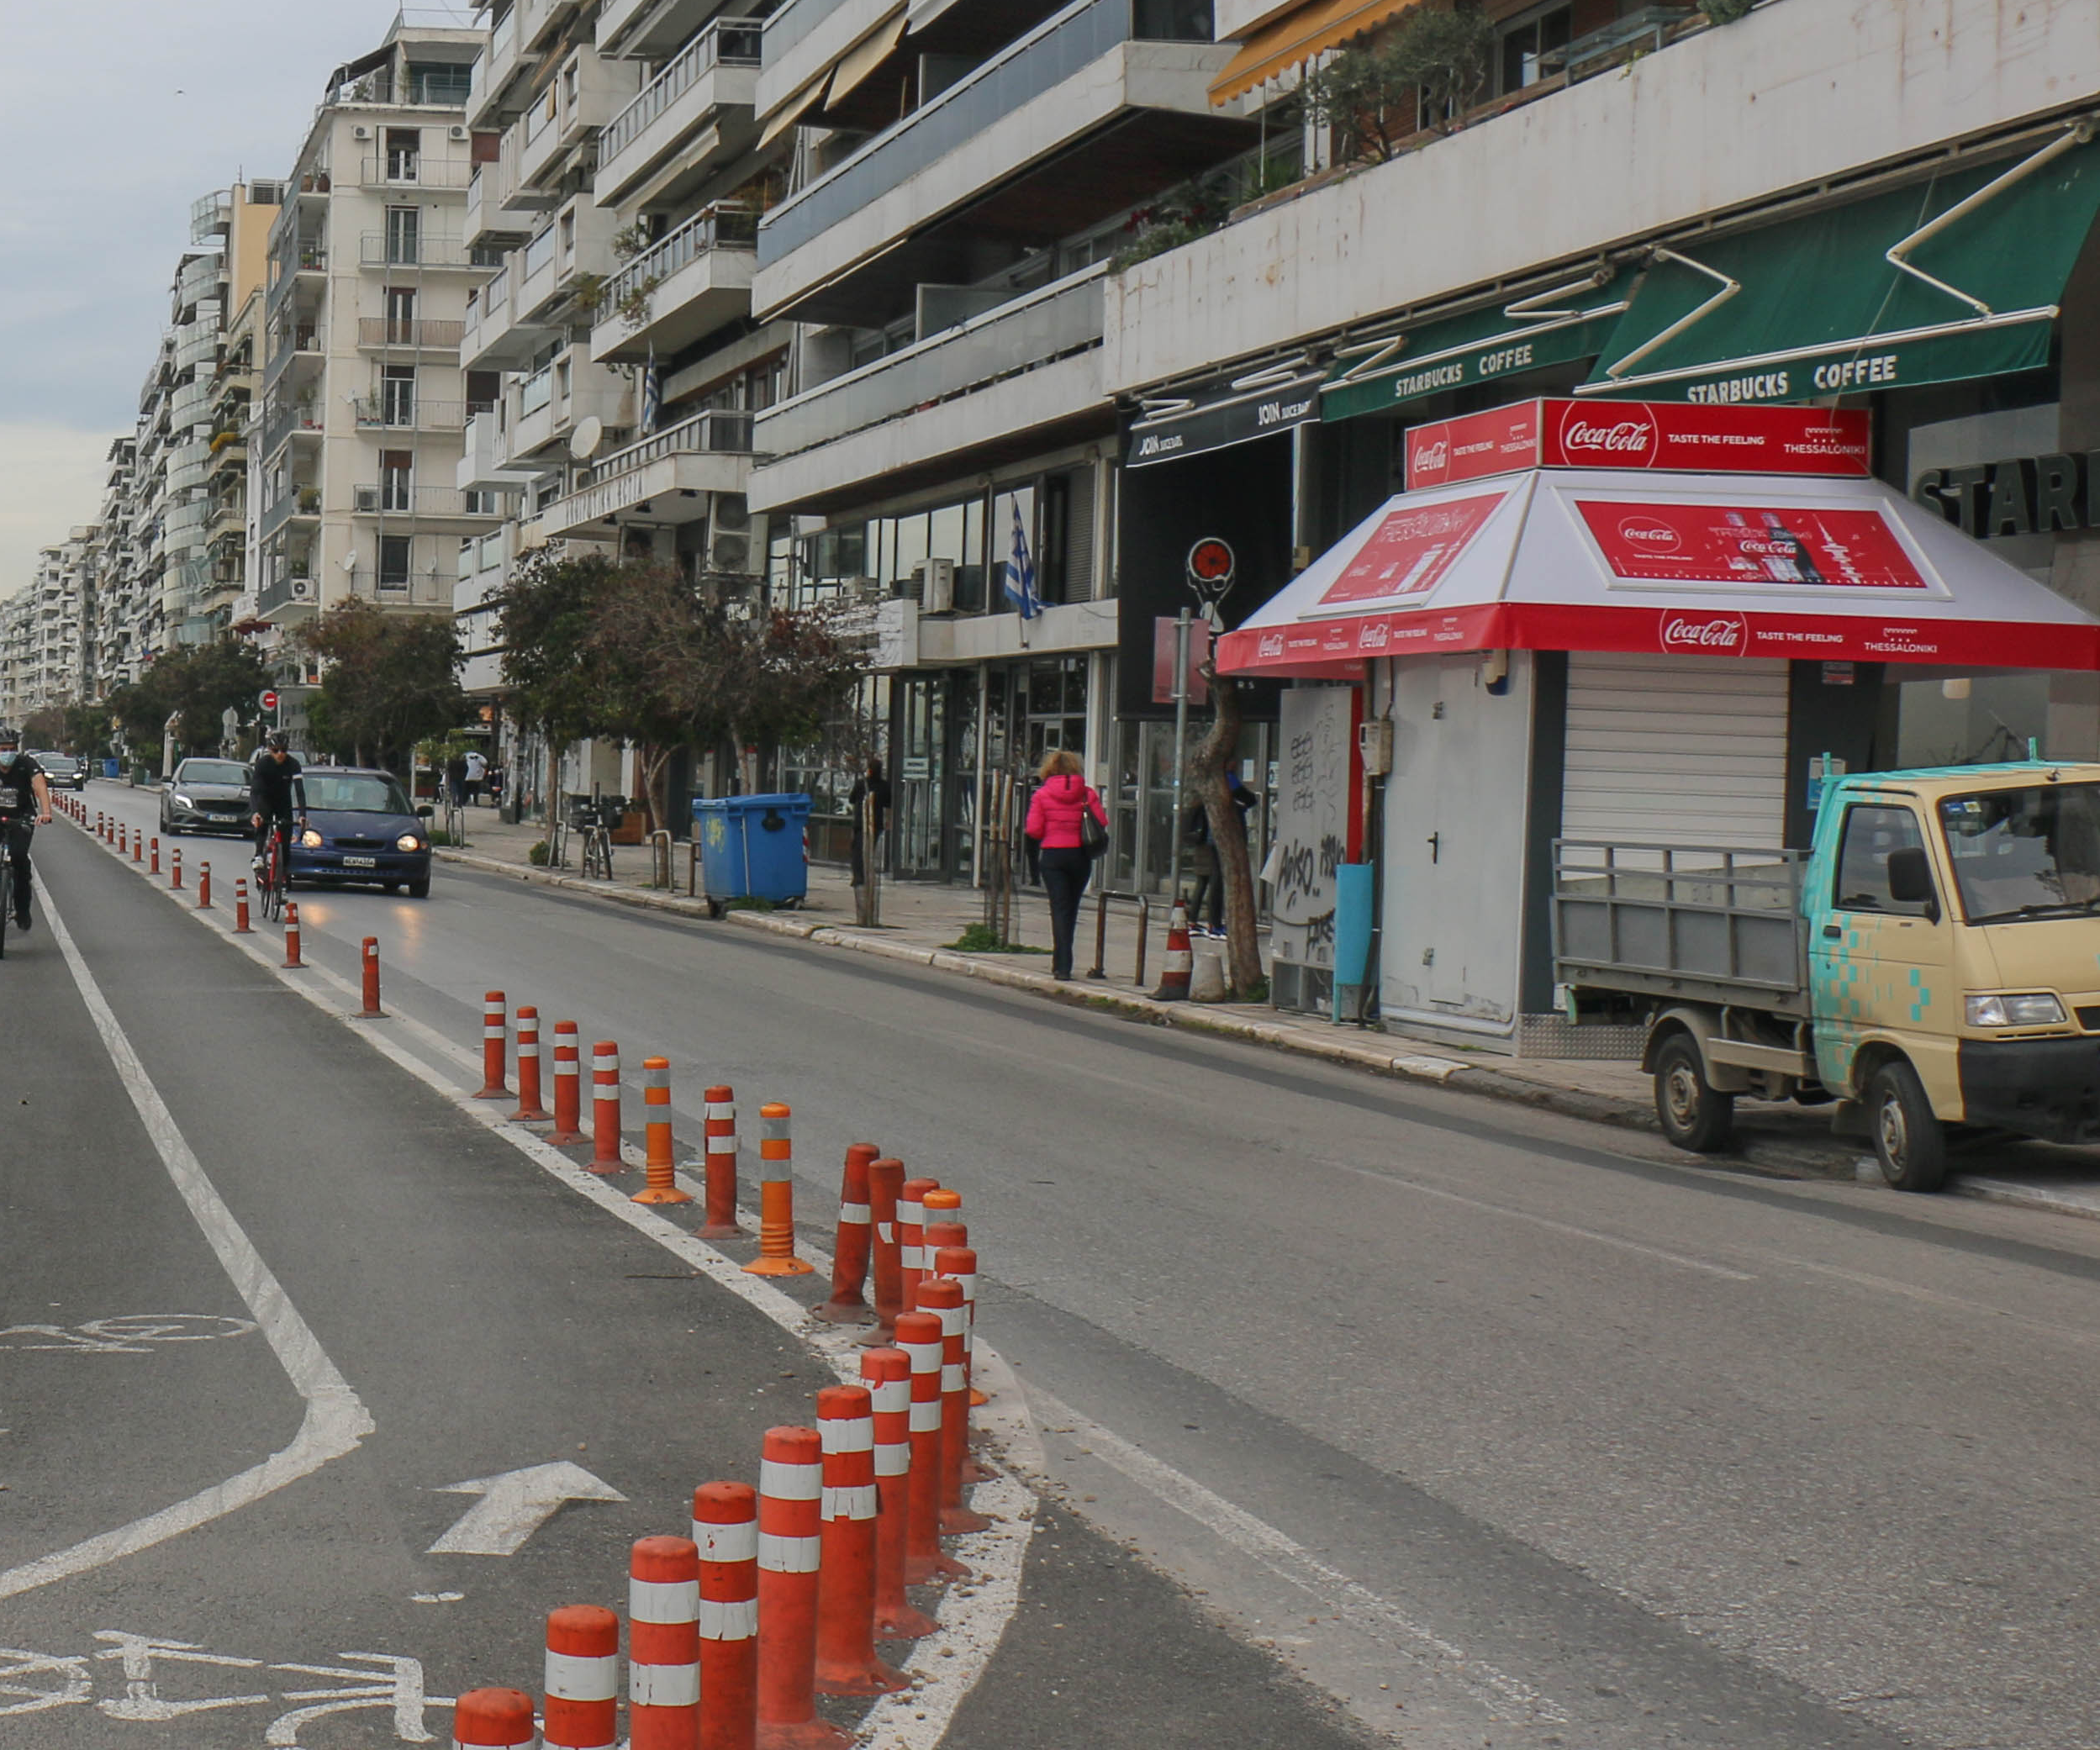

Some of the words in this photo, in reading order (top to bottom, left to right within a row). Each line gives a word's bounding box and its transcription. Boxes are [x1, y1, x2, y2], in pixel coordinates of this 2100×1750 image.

[1396, 363, 1463, 397] STARBUCKS
[1480, 345, 1533, 375] COFFEE
[1688, 372, 1788, 403] STARBUCKS
[1814, 356, 1897, 389] COFFEE
[1258, 402, 1280, 425] JOIN
[1139, 435, 1159, 456] JOIN
[1565, 421, 1652, 451] Coca-Cola
[1668, 434, 1699, 444] TASTE
[1701, 435, 1721, 444] THE
[1723, 435, 1765, 445] FEELING
[1784, 444, 1865, 454] THESSALONIKI
[1665, 619, 1741, 646] Coca-Cola
[1756, 631, 1784, 640] TASTE
[1786, 632, 1803, 641] THE
[1805, 633, 1844, 643] FEELING
[1864, 642, 1937, 653] THESSALONIKI
